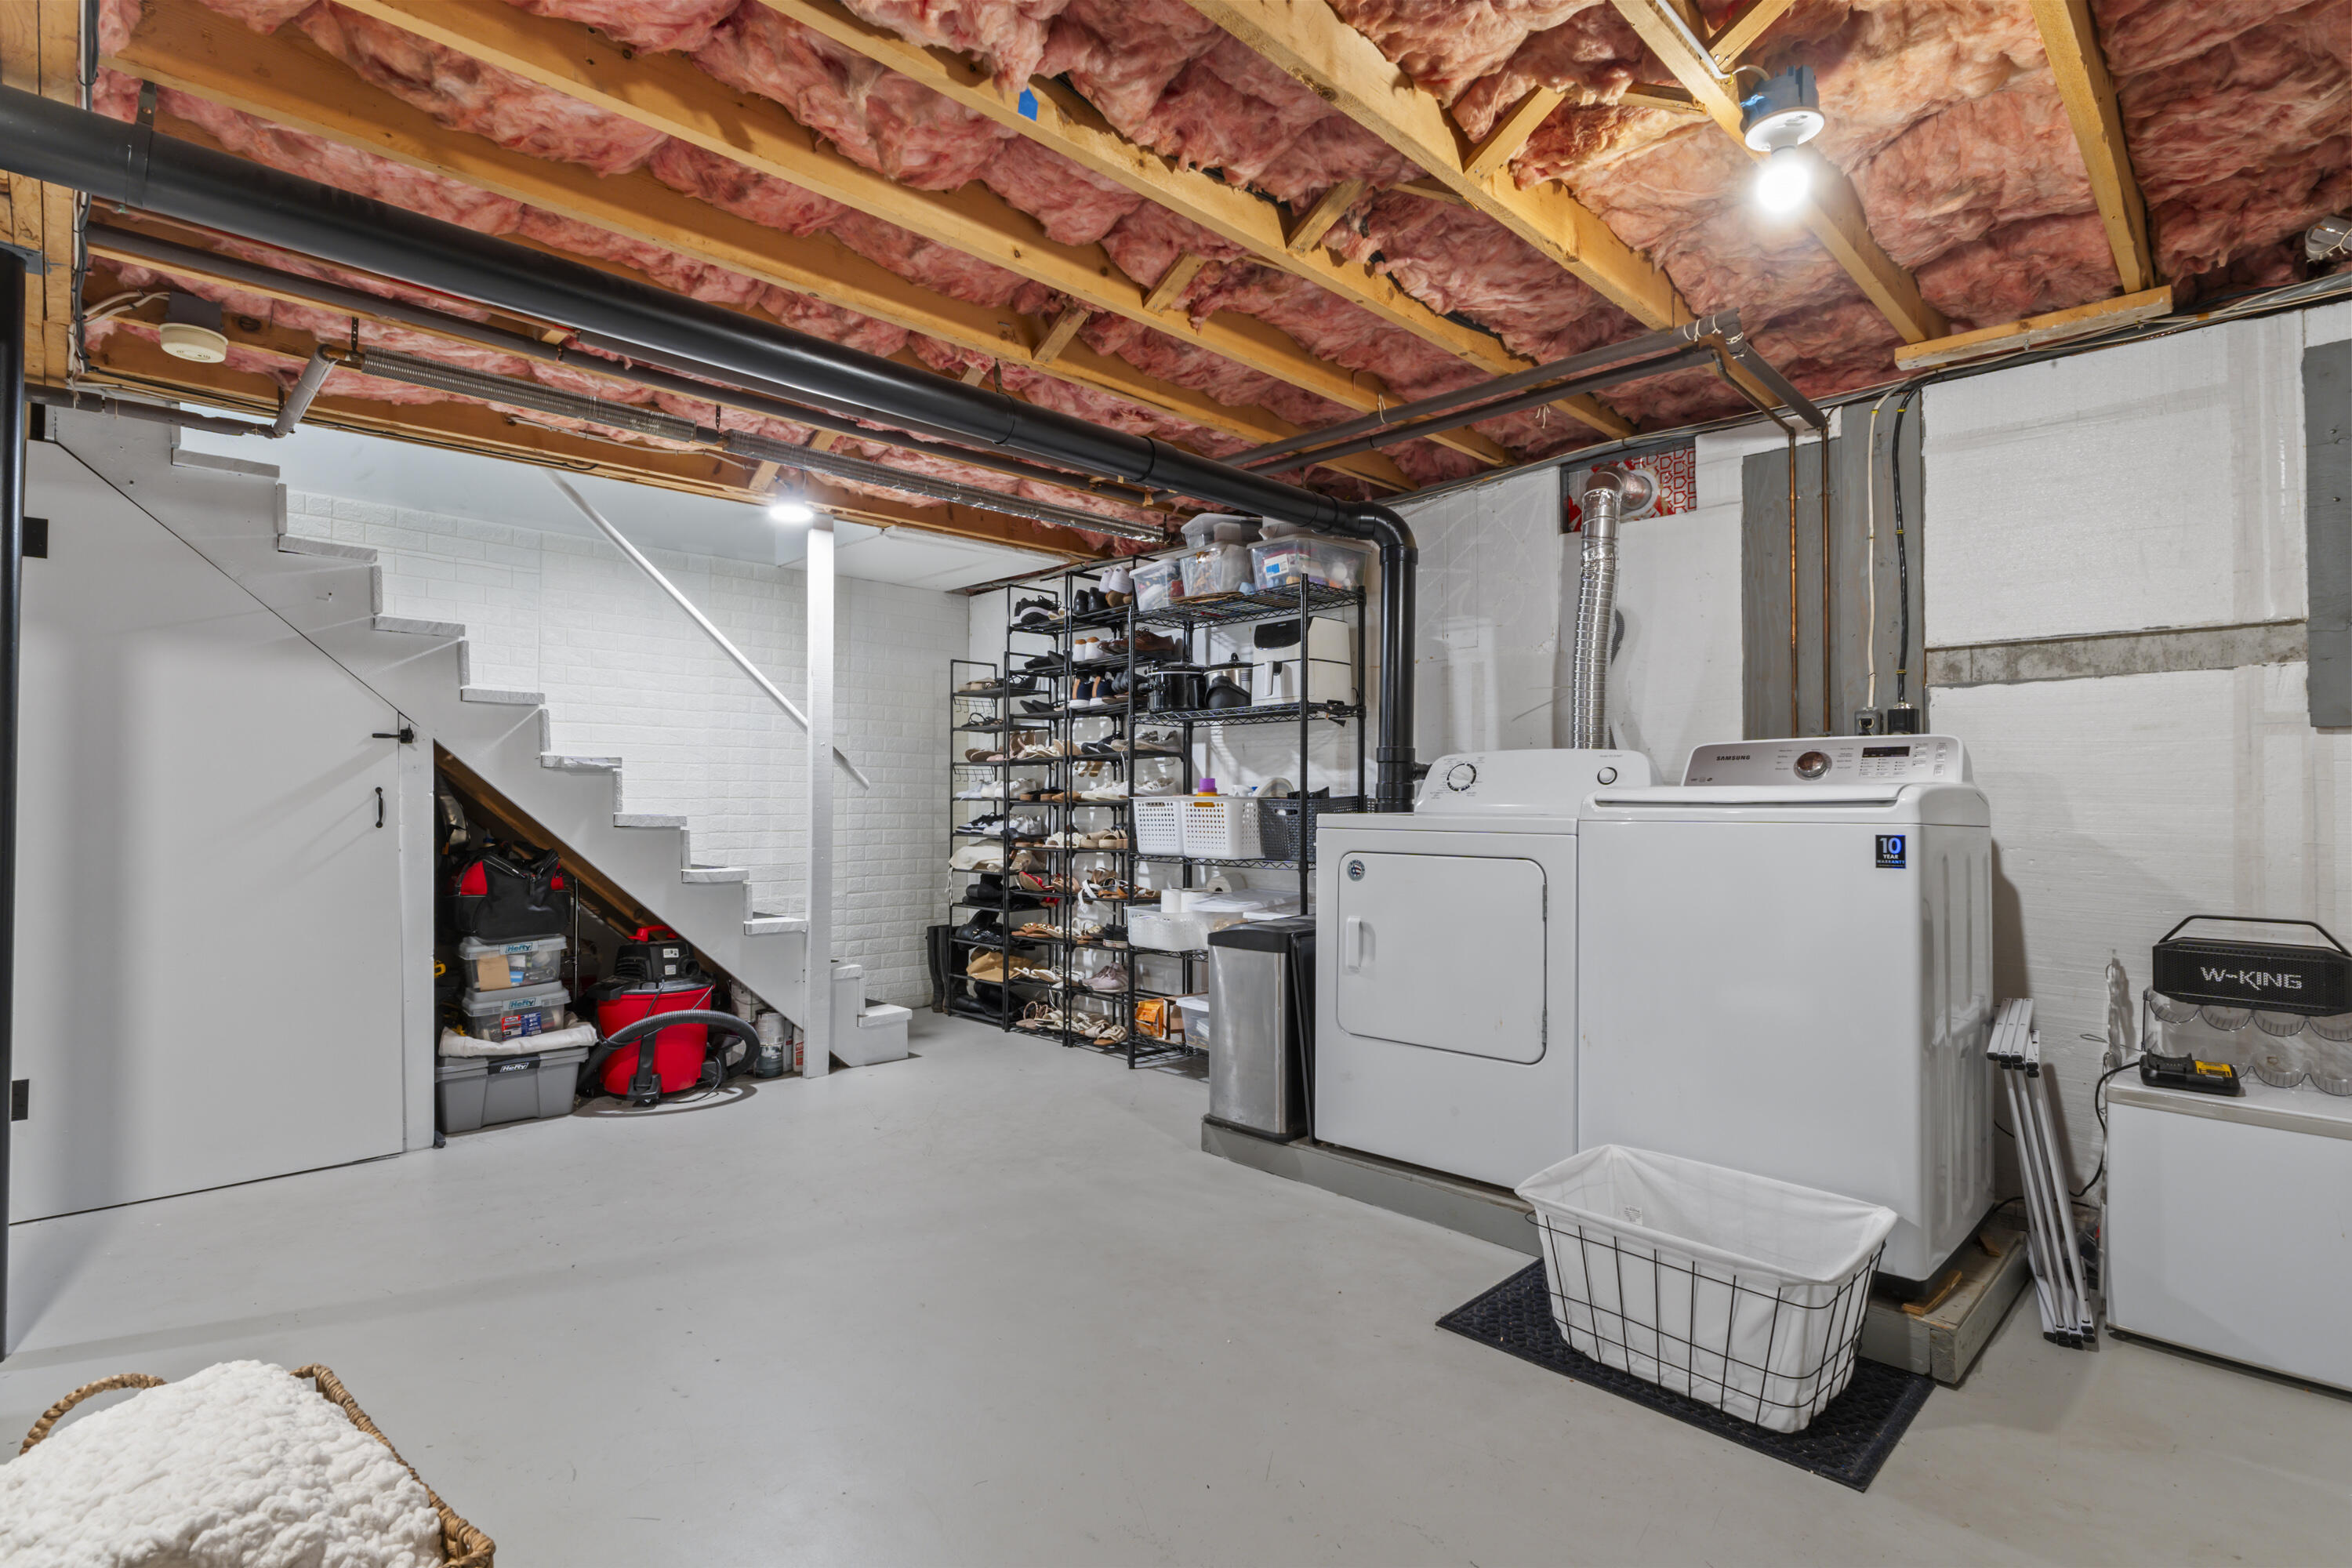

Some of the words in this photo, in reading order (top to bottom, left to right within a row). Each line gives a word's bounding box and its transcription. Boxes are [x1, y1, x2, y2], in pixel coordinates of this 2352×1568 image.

[1879, 837, 1901, 855] 10
[506, 943, 532, 953] Hefty
[2200, 967, 2302, 990] W-KING
[510, 999, 535, 1008] Hefty
[502, 1063, 528, 1072] Hefty
